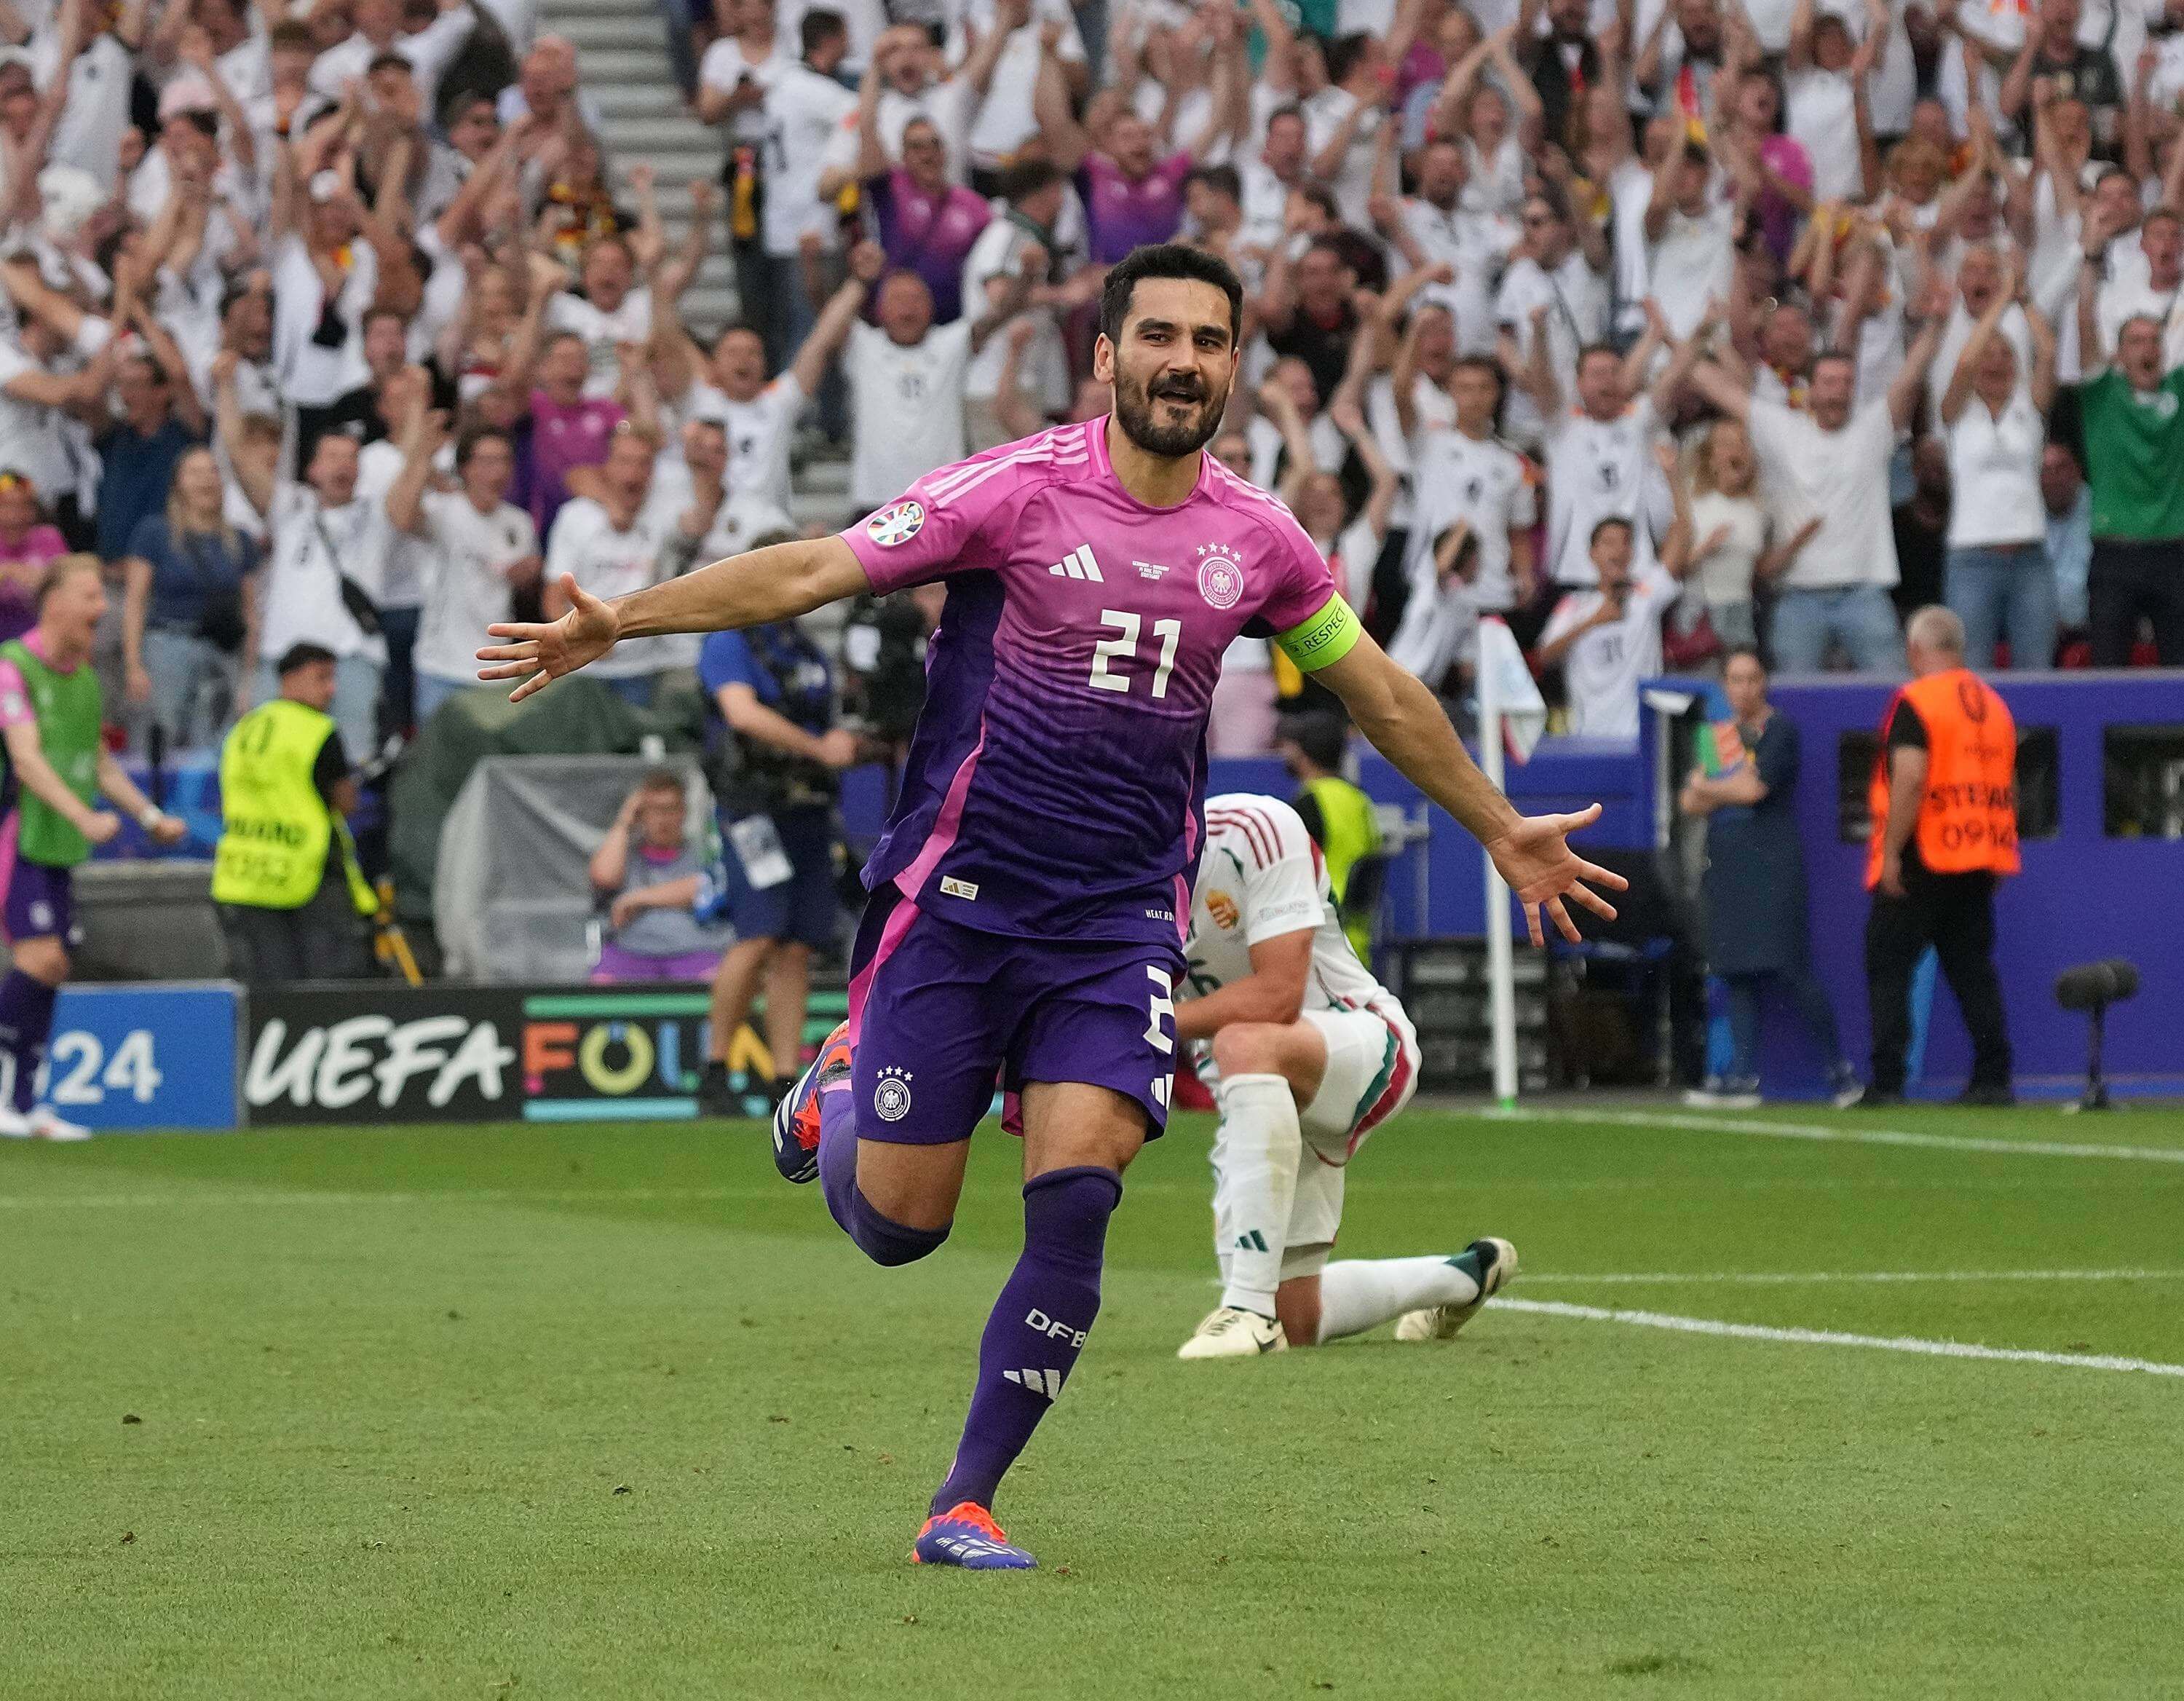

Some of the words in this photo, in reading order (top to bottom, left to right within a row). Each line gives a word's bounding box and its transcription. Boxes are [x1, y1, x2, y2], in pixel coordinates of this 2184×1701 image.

[1089, 609, 1182, 698] 21
[1303, 605, 1345, 650] RESPECT
[244, 1014, 515, 1107] UEFA
[1025, 1309, 1086, 1348] DFB
